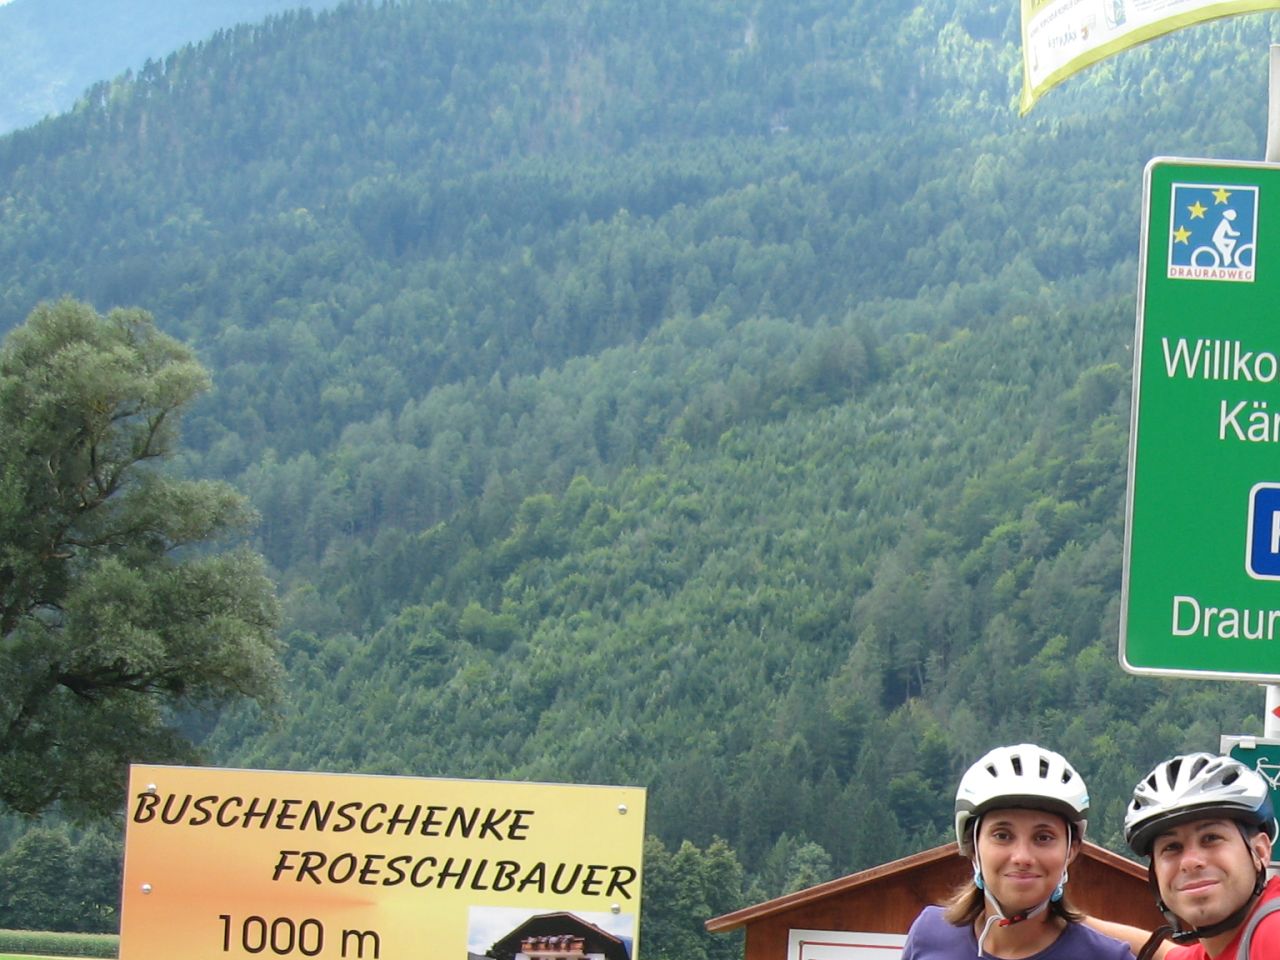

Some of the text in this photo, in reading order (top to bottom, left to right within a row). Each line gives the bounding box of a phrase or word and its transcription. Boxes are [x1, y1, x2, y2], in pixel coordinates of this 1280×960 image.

[1170, 267, 1252, 280] DRAURADWEG
[134, 791, 534, 841] BUSCHENSCHENKE
[272, 849, 637, 900] FROESCHLBAUER
[218, 914, 381, 959] 1000 m
